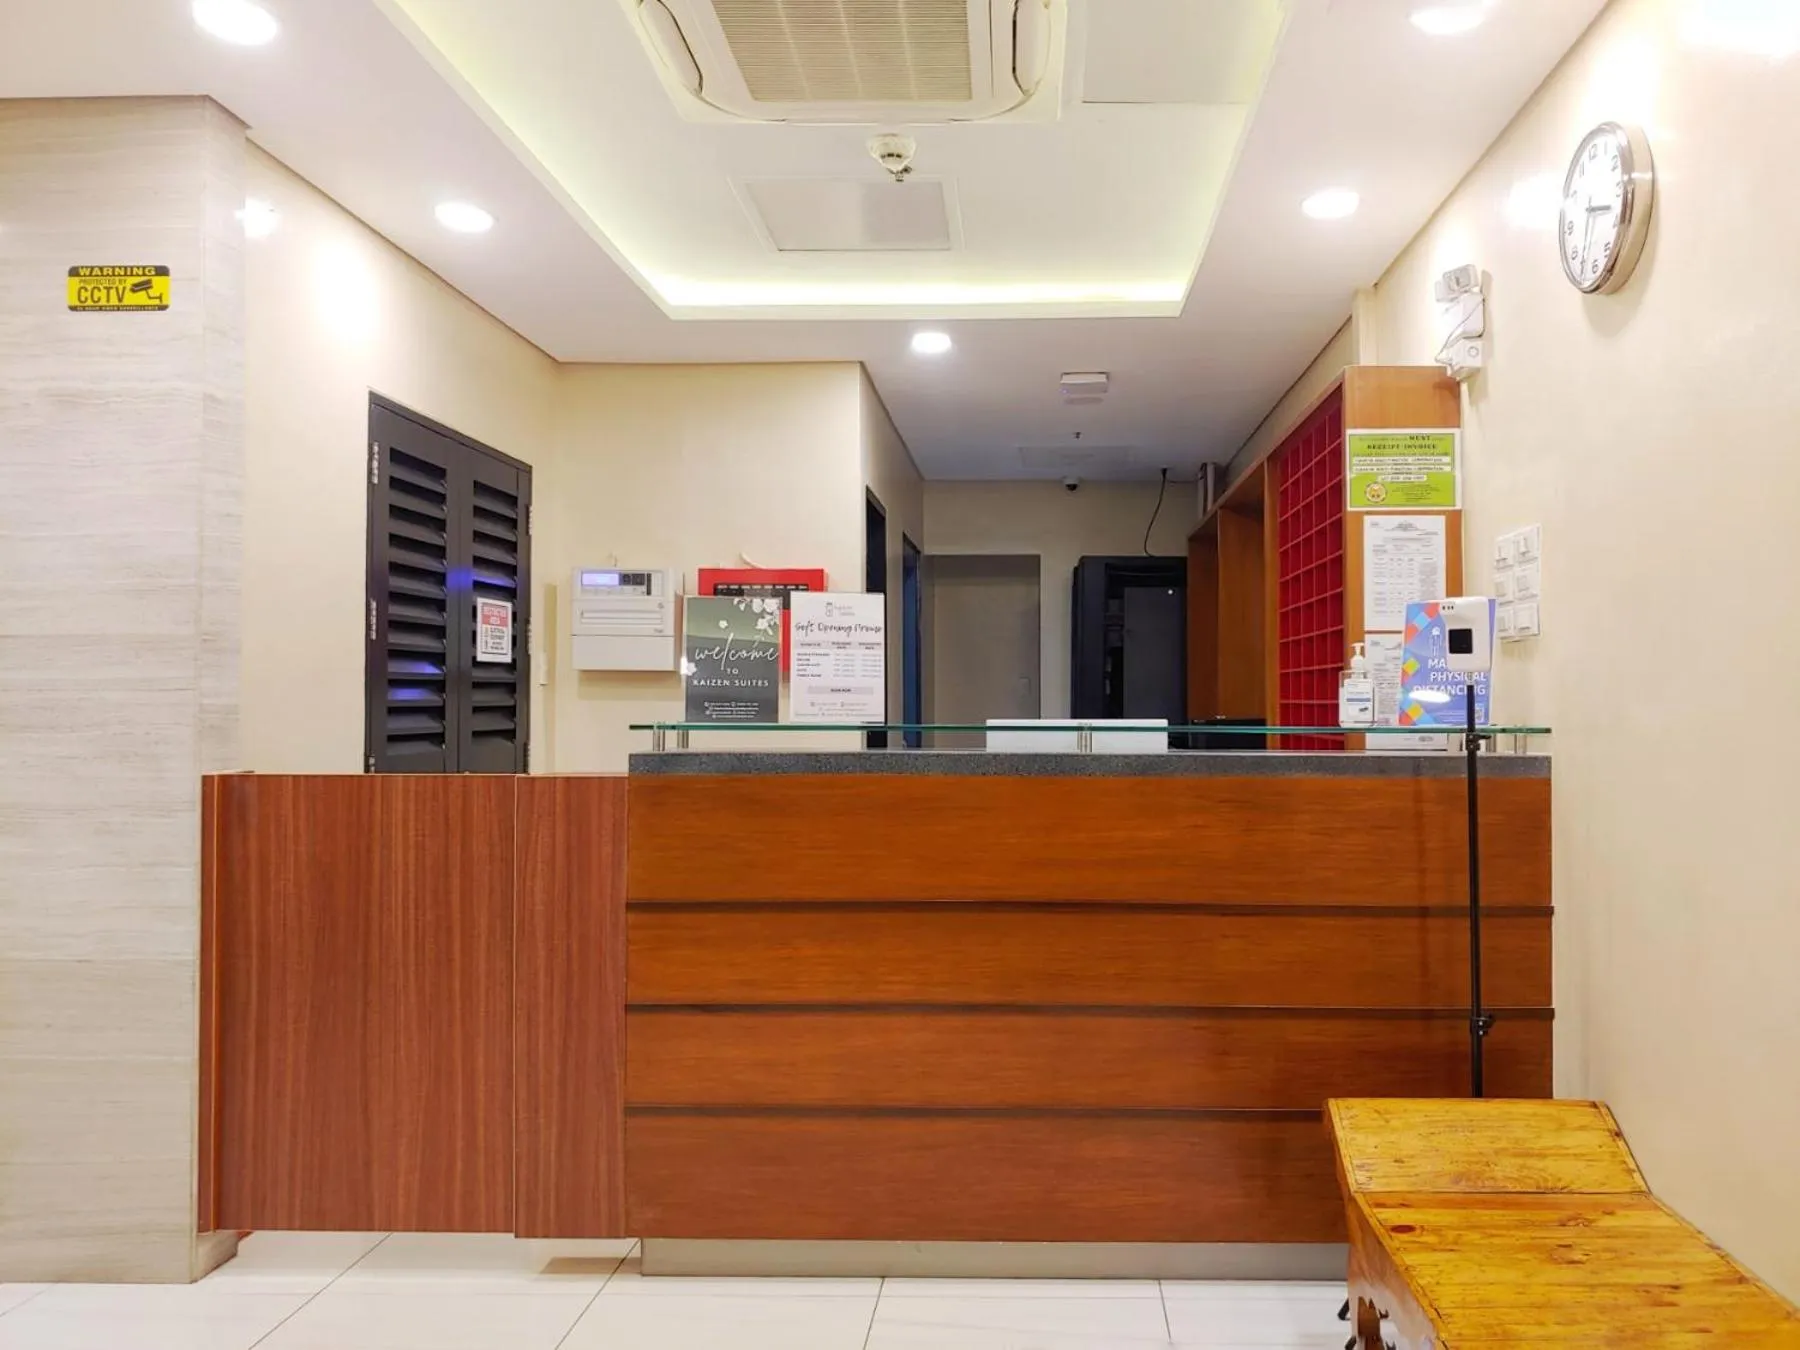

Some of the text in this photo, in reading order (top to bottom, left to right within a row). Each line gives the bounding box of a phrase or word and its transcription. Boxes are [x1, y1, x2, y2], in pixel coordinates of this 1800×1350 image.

[1588, 143, 1598, 162] 12
[1611, 154, 1619, 172] 2
[79, 267, 156, 276] WARNING
[77, 286, 127, 304] CCTV
[817, 622, 852, 638] Opening
[694, 632, 779, 671] welcome
[726, 667, 739, 675] TO
[693, 679, 769, 687] KAIZEN SUITES
